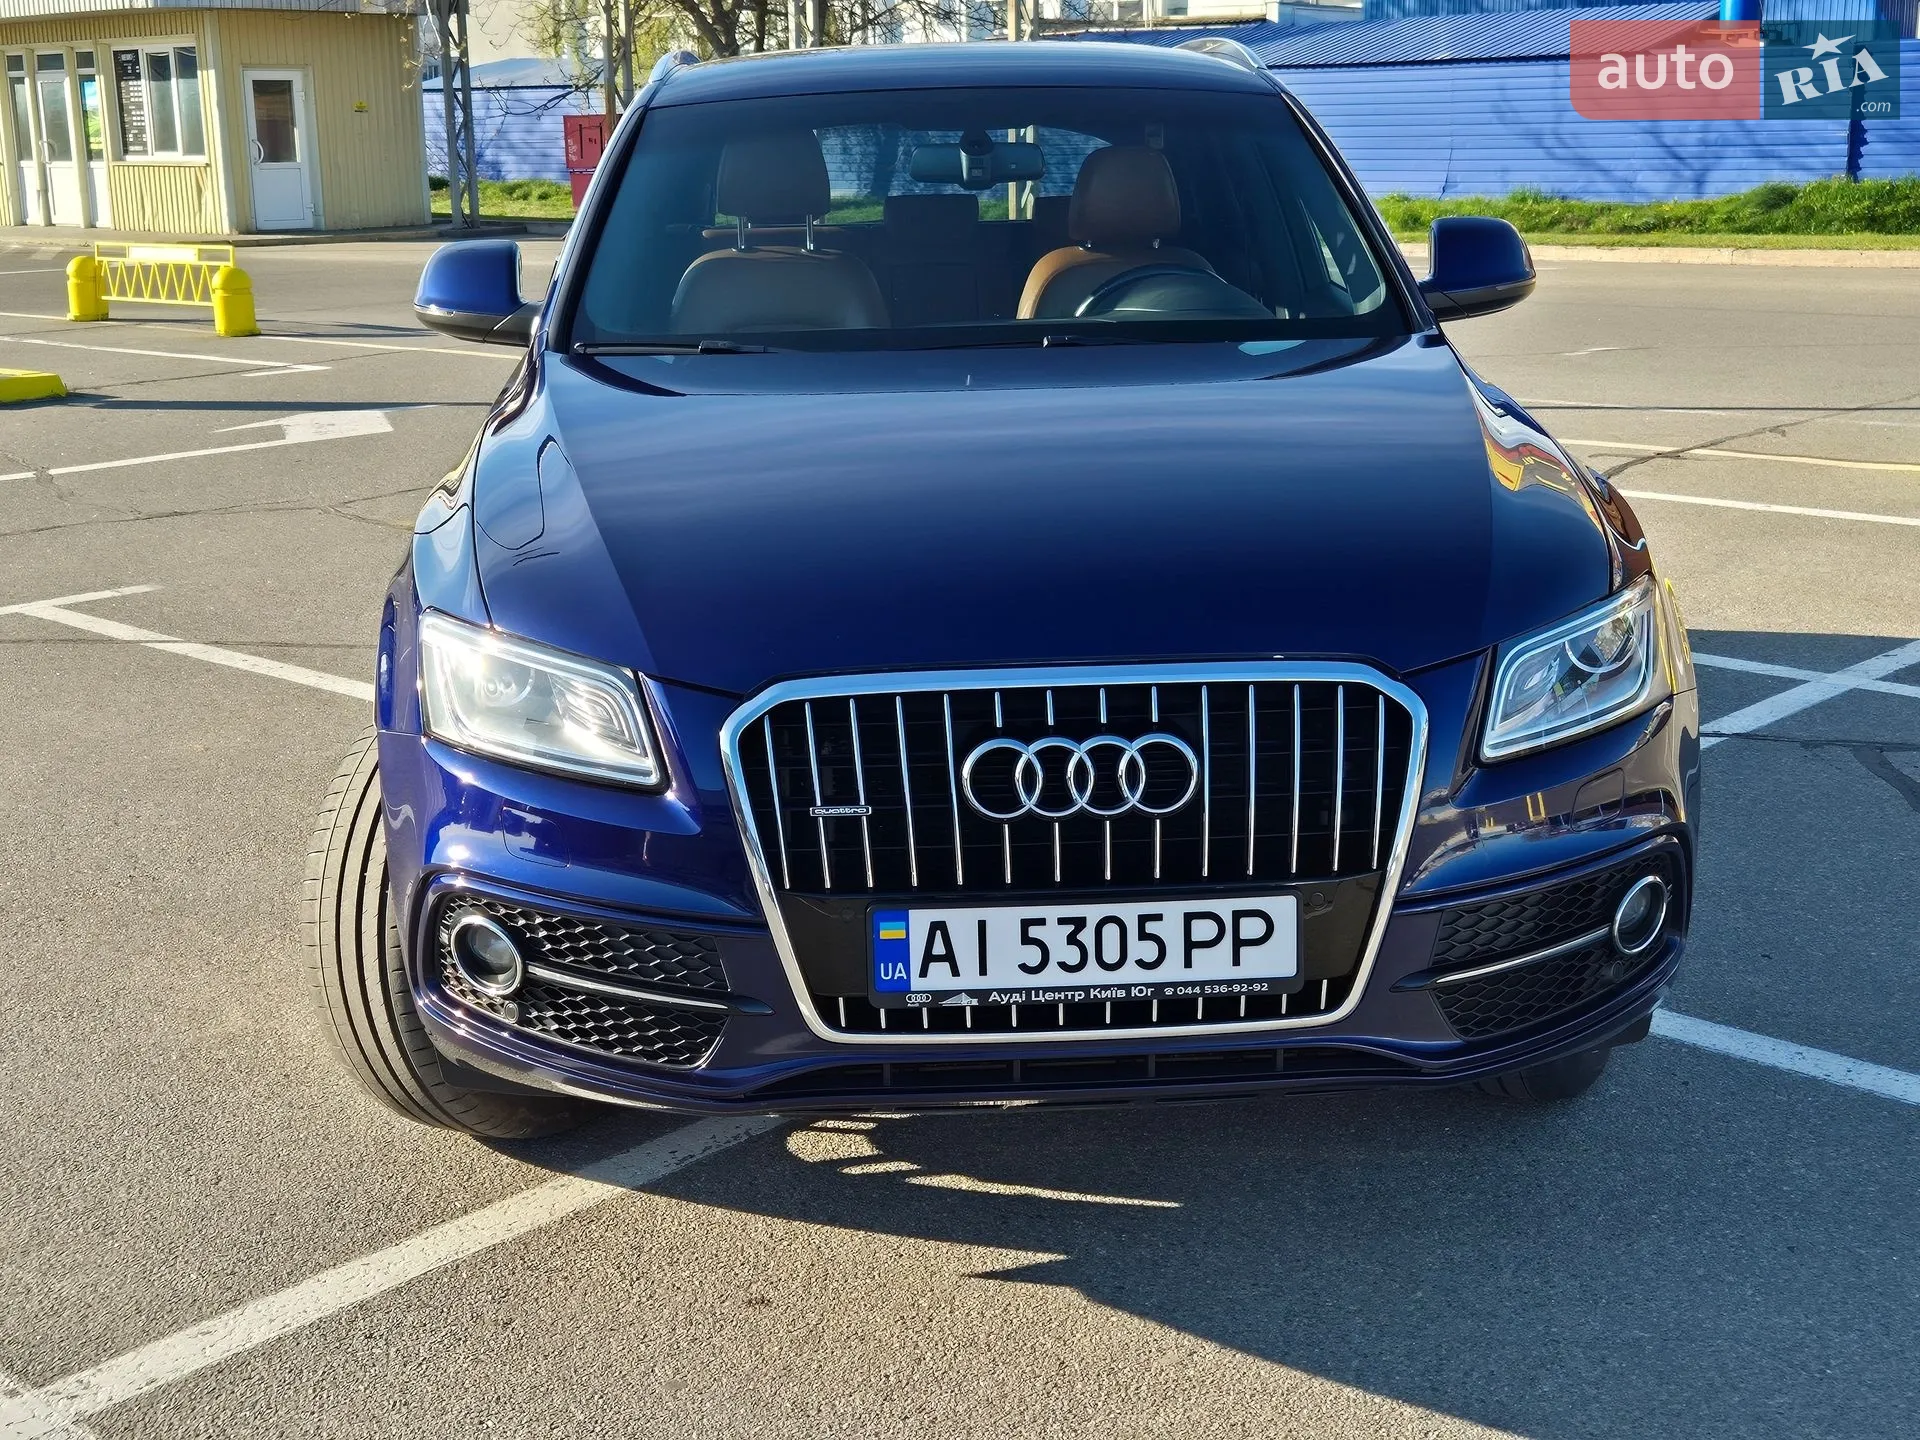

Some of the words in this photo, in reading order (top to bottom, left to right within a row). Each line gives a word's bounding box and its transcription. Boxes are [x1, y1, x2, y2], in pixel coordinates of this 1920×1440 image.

[814, 807, 868, 816] quattro
[918, 919, 988, 979] AI
[1017, 913, 1167, 974] 5305
[1183, 908, 1275, 968] PP
[880, 962, 907, 980] UA
[988, 990, 1027, 1005] Ауді
[1031, 989, 1086, 1004] Центр
[1090, 986, 1126, 999] Київ
[1131, 986, 1155, 997] Юг
[1176, 986, 1201, 995] 044
[1204, 983, 1269, 994] 536-92-92
